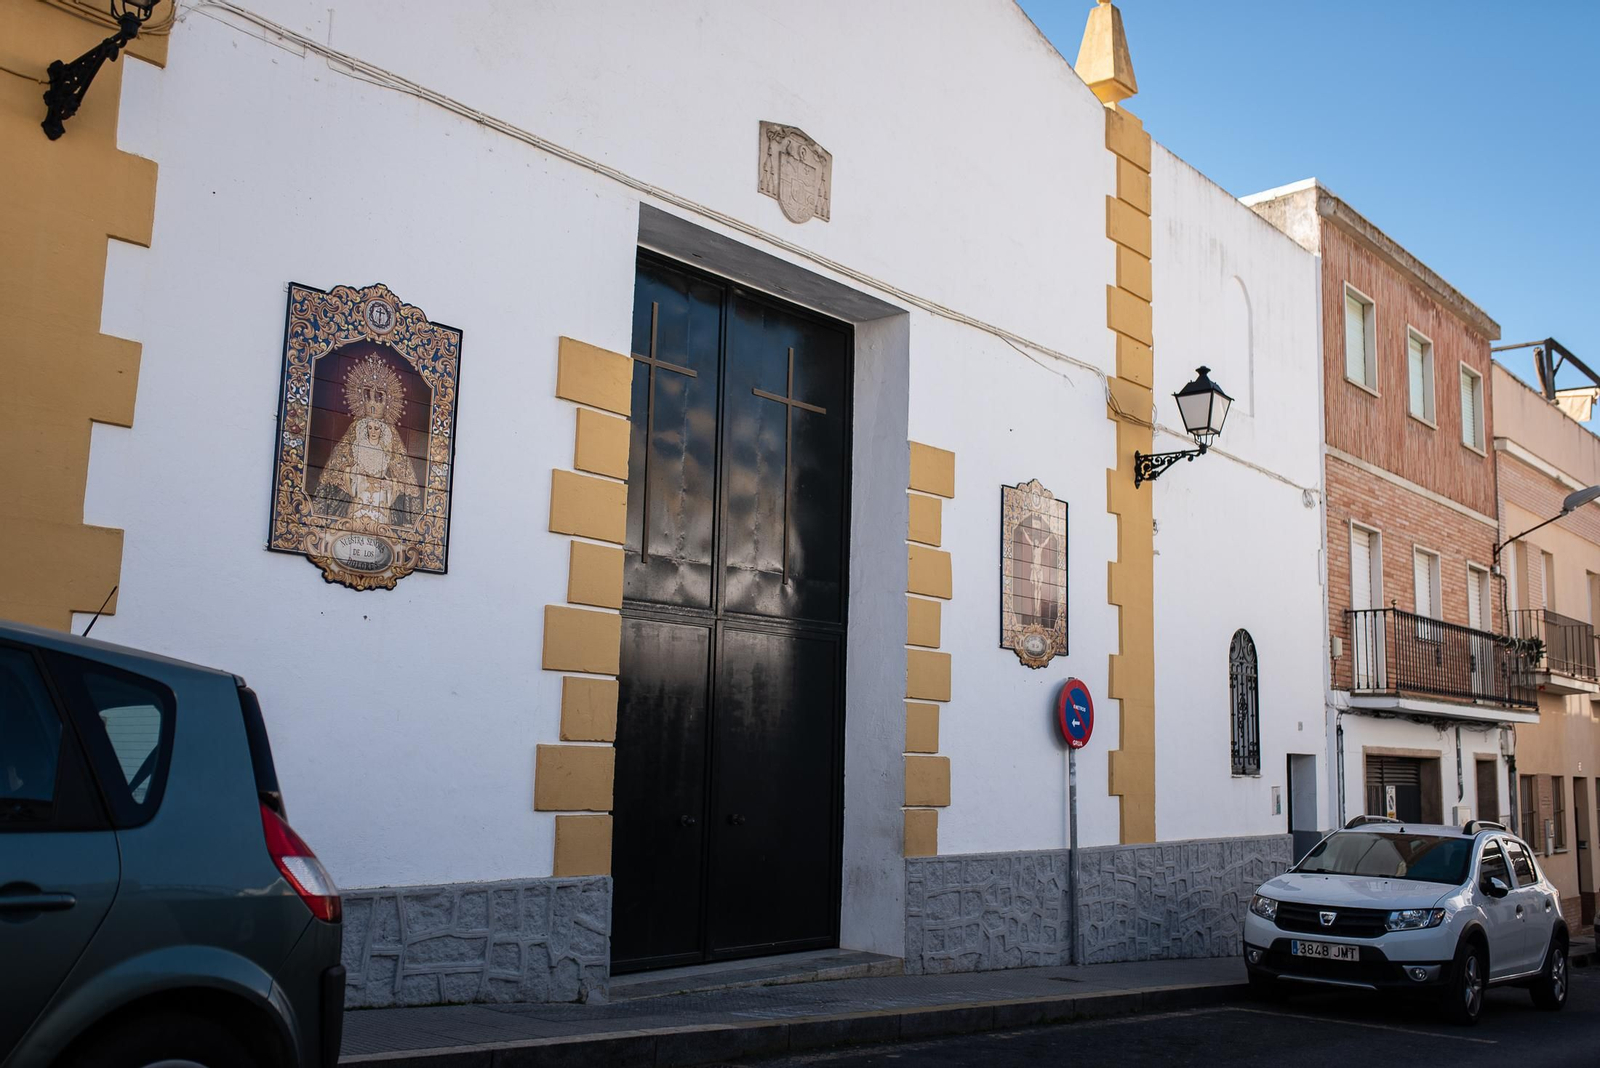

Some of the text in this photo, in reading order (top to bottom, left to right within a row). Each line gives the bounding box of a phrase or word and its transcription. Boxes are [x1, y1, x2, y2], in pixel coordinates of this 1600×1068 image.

[364, 550, 374, 558] LOS
[1300, 943, 1356, 959] 3848 JMT
